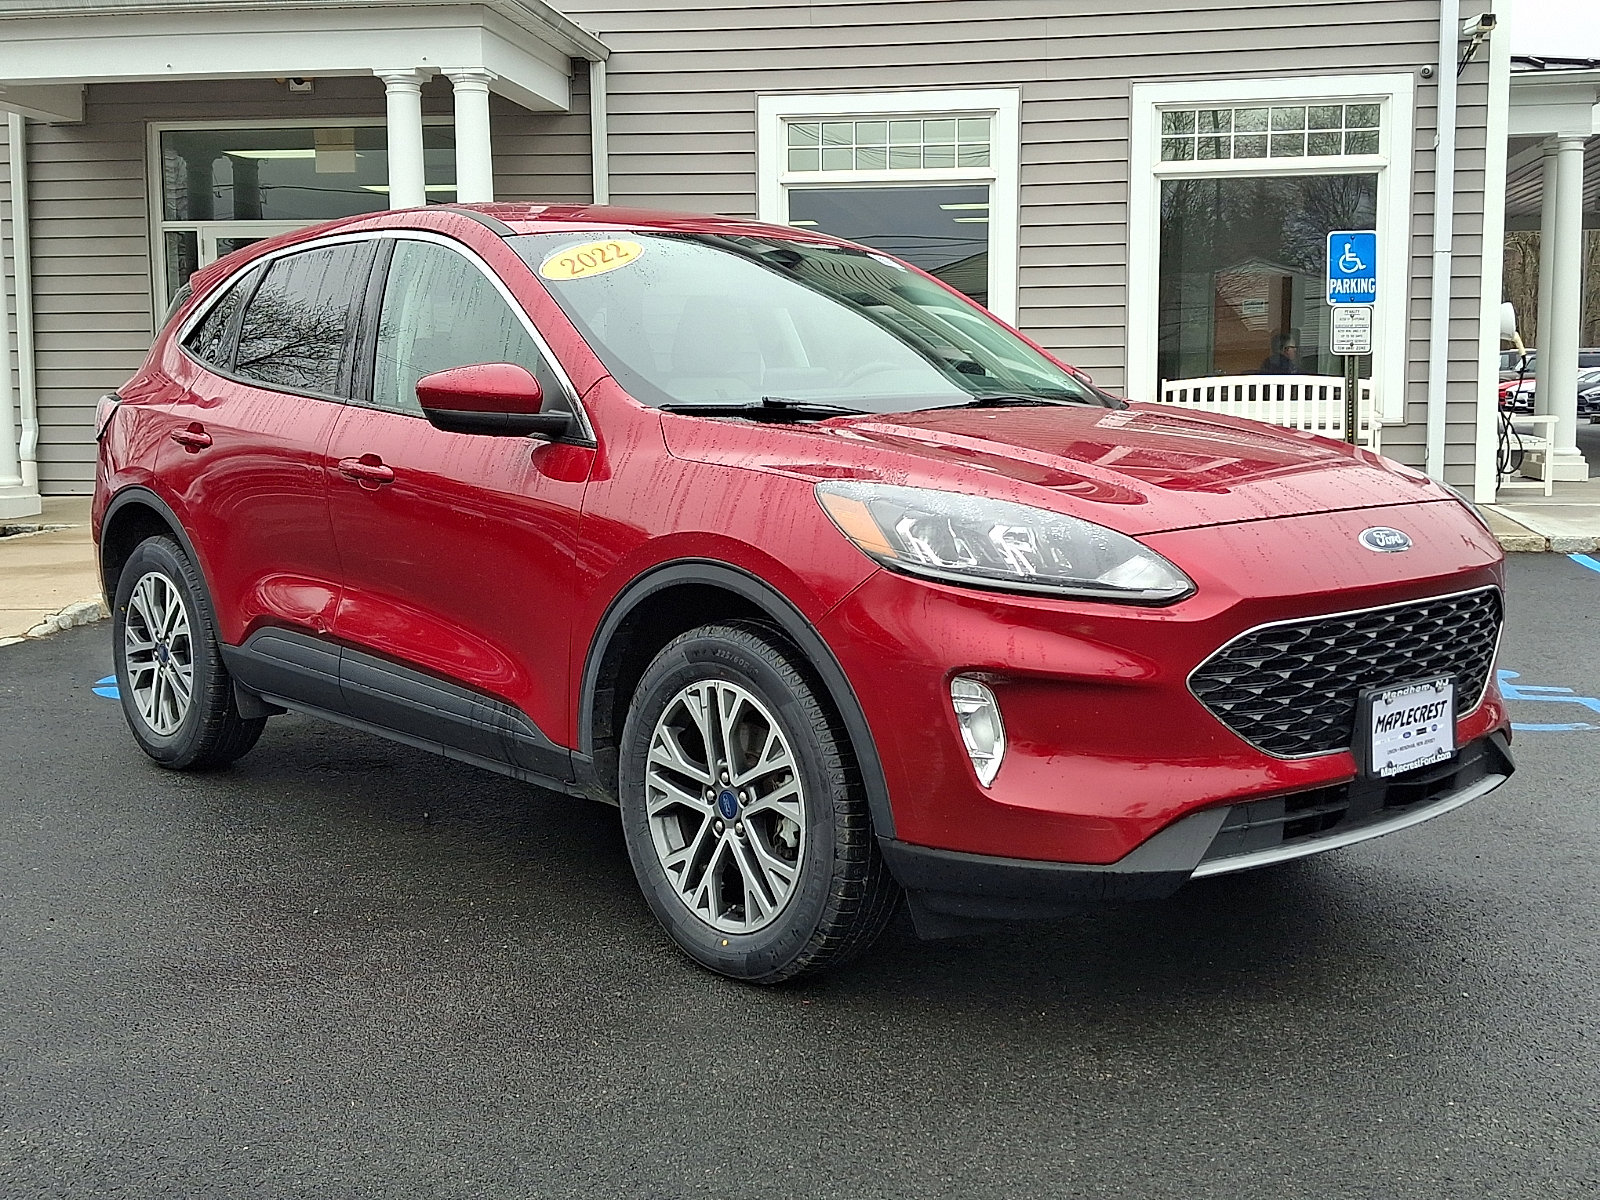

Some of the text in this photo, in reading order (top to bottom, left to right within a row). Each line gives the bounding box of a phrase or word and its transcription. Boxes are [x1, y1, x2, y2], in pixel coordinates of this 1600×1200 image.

[560, 243, 629, 275] 2022
[1329, 277, 1376, 294] PARKING
[1372, 530, 1404, 546] Ford
[1435, 678, 1450, 688] NJ
[1374, 700, 1448, 735] MAPLECREST
[1380, 751, 1452, 777] MaplecrestFord.com
